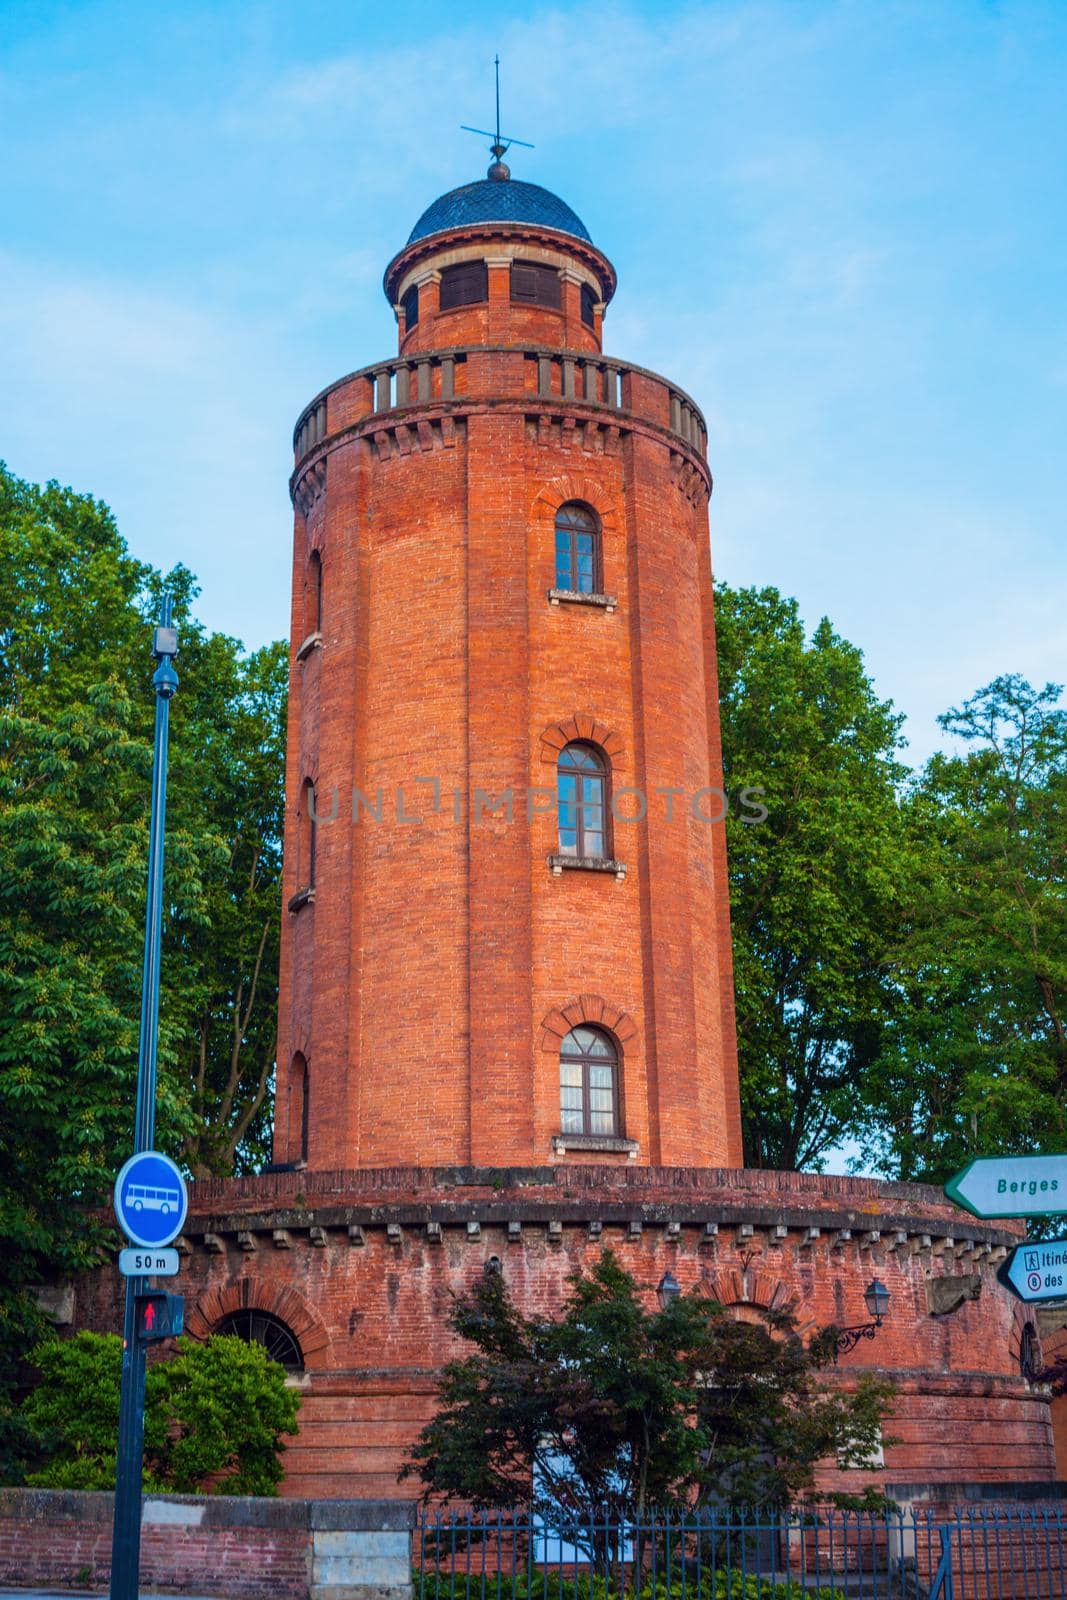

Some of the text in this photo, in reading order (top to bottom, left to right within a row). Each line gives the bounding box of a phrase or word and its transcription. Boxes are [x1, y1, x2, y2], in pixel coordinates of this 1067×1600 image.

[997, 1178, 1058, 1195] Berges
[135, 1255, 166, 1269] 50 m
[1044, 1273, 1063, 1288] des
